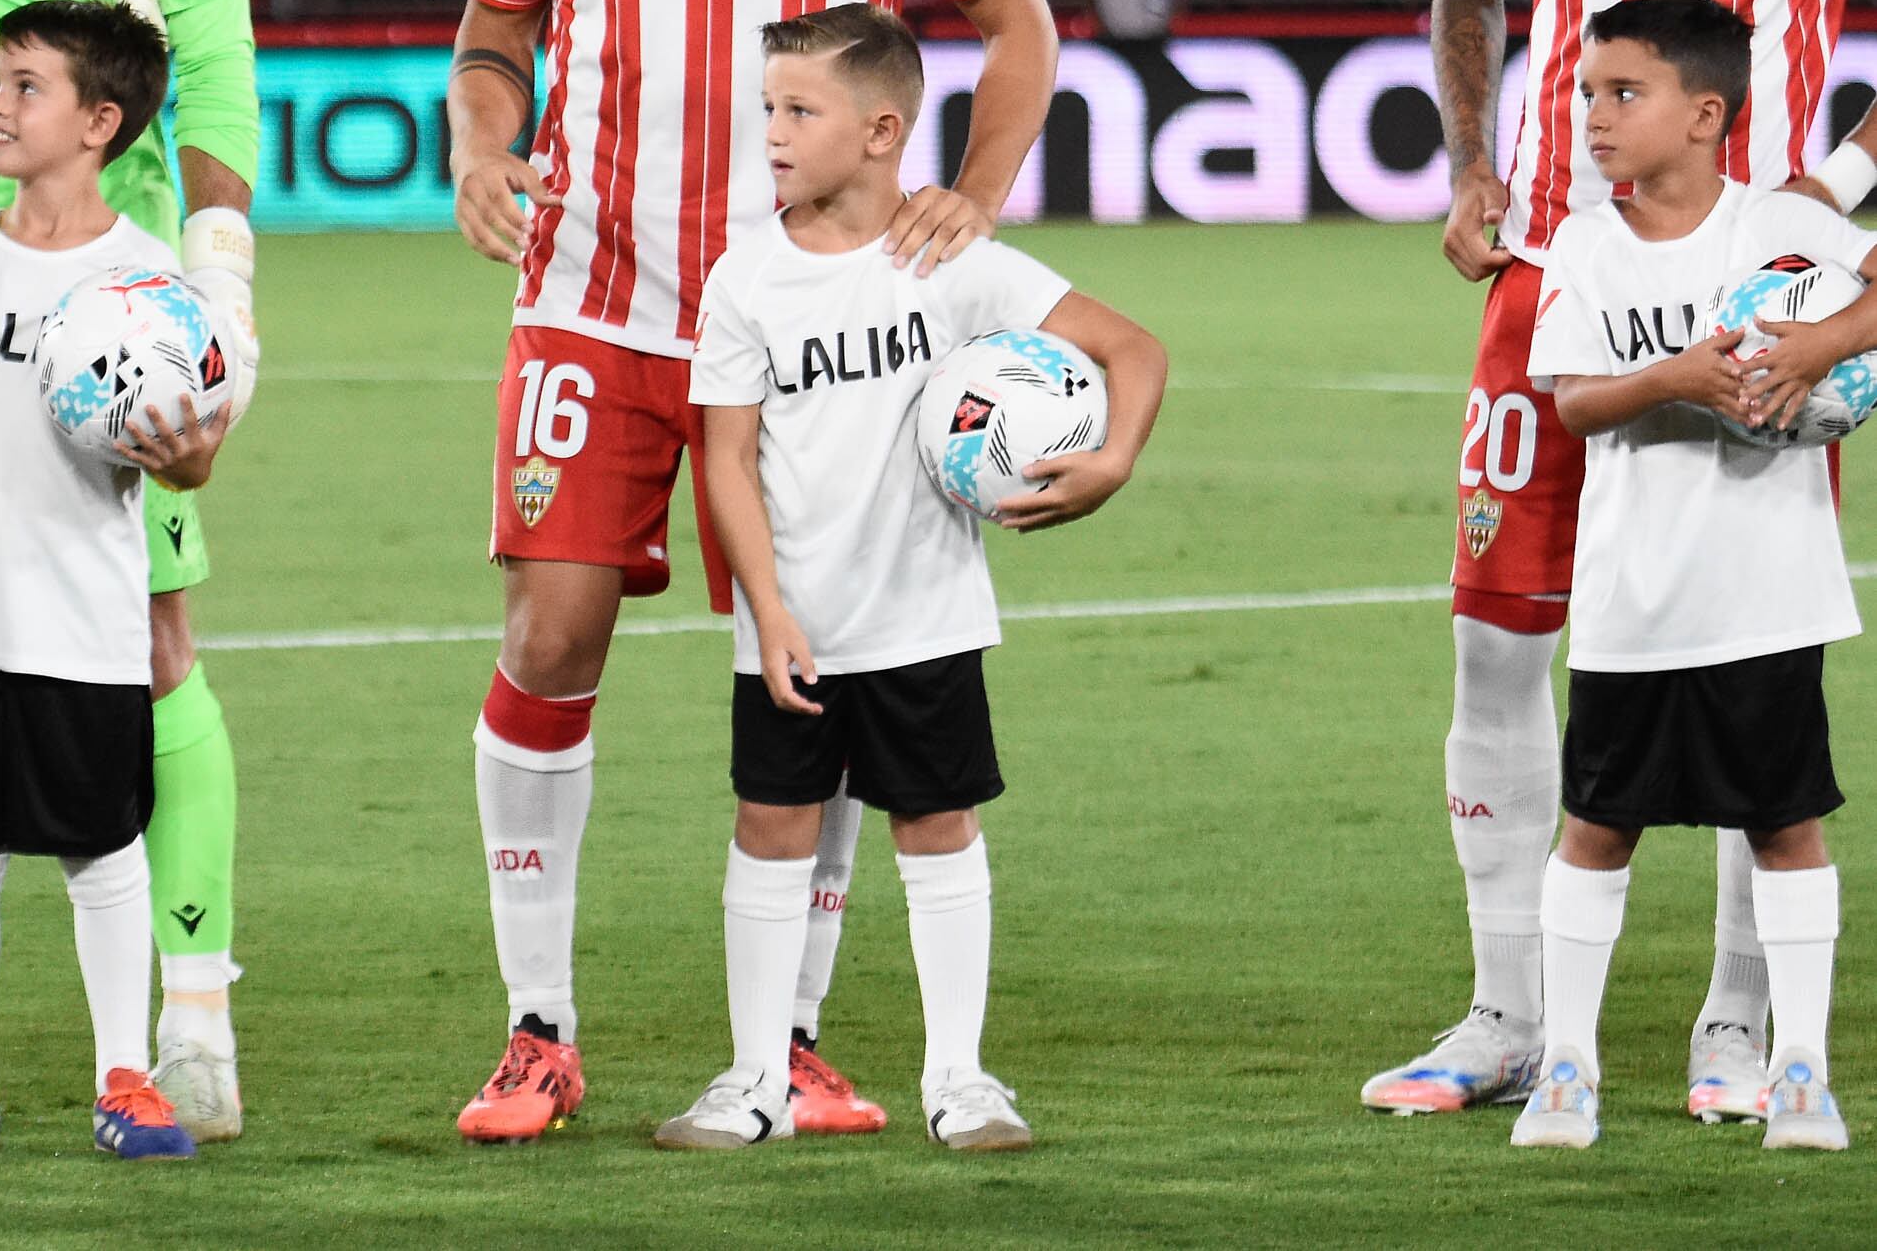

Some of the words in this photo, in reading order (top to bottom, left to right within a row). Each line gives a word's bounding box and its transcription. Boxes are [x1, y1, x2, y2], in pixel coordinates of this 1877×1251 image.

[765, 311, 932, 395] LALIGA
[1601, 303, 1696, 362] LALI
[515, 360, 595, 459] 16
[1459, 388, 1538, 492] 20
[1449, 795, 1493, 819] DA
